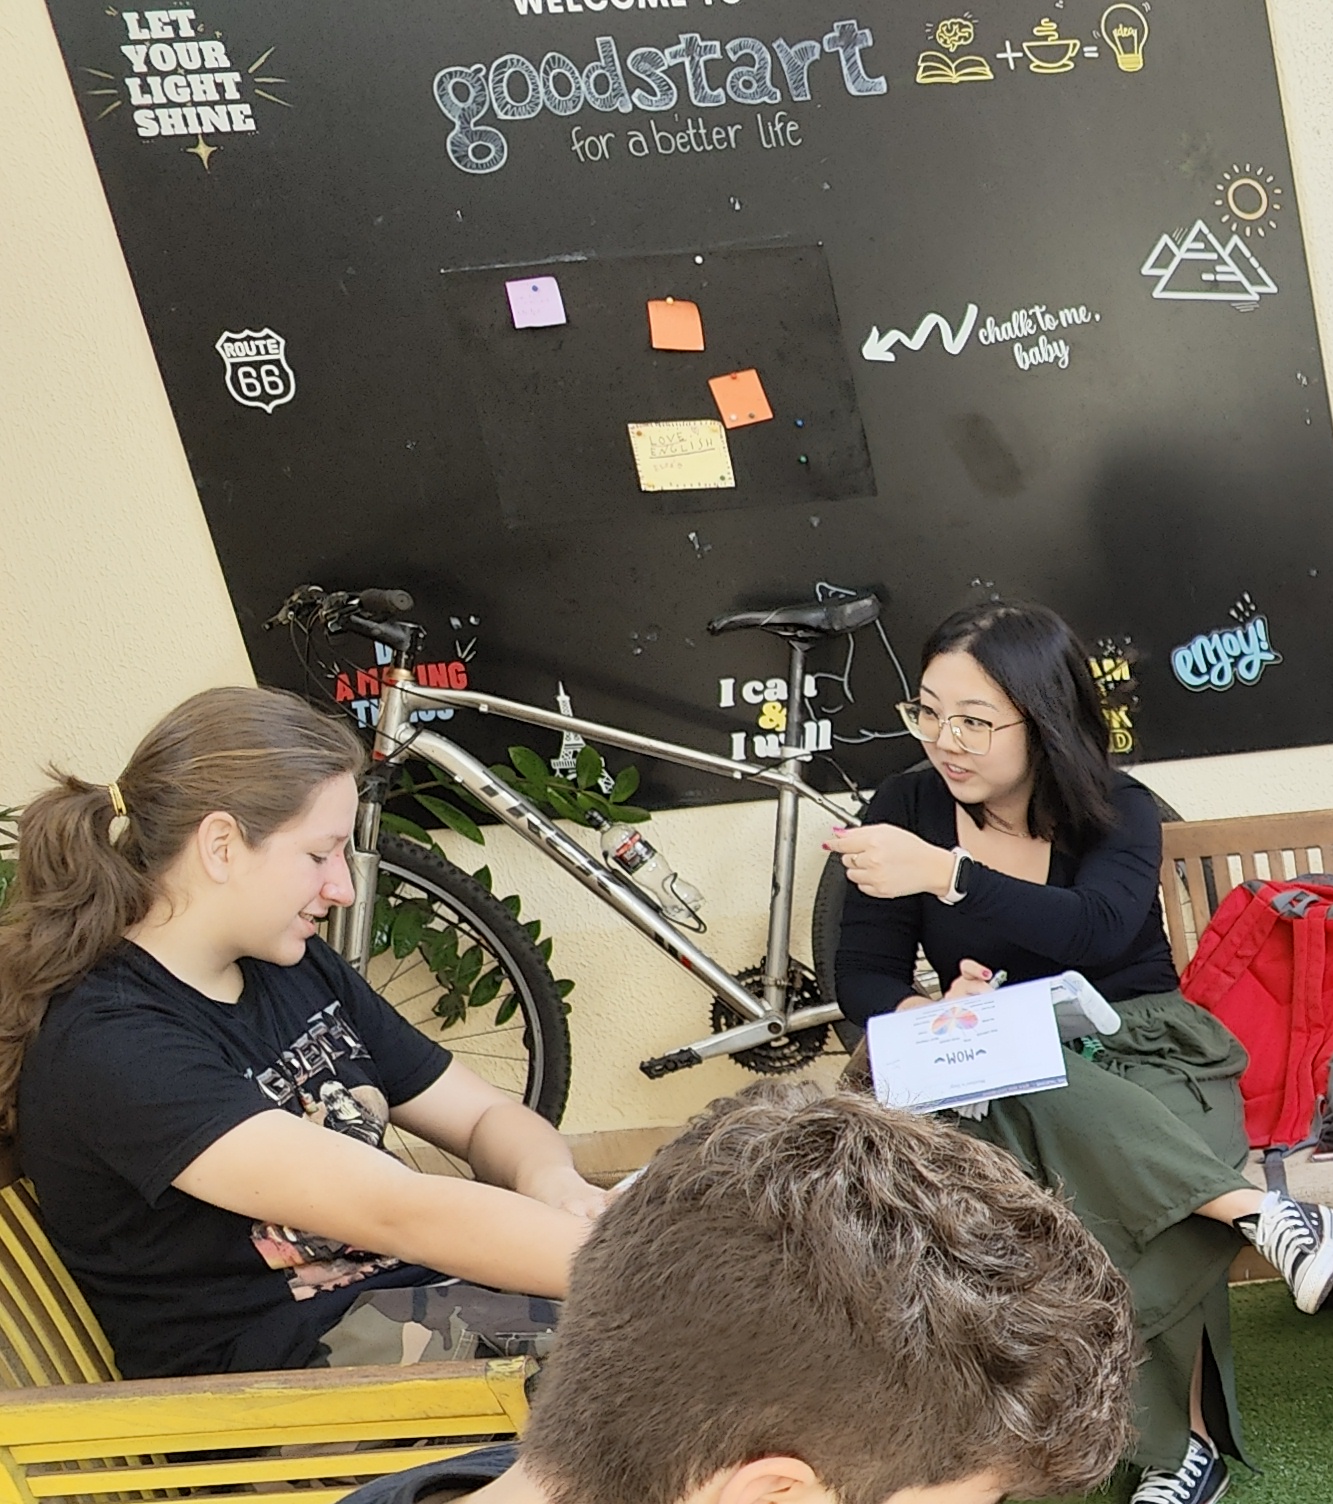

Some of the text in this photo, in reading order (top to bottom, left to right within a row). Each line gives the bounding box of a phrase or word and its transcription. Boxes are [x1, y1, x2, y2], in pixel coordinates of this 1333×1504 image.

[122, 9, 195, 40] LET
[121, 40, 231, 73] YOUR
[125, 72, 242, 106] LIGHT
[433, 19, 888, 174] goodstart
[133, 103, 256, 137] SHINE
[571, 111, 803, 163] for a better life
[978, 309, 1037, 345] chalk
[1029, 304, 1058, 331] to
[224, 339, 280, 358] ROUTE
[1013, 335, 1070, 371] baby
[237, 365, 284, 398] 66
[649, 432, 686, 447] LOVE
[650, 438, 713, 457] ENGLISH
[1174, 619, 1275, 687] enjoy!
[719, 678, 735, 707] I
[731, 732, 746, 760] I
[946, 1049, 975, 1065] MOM
